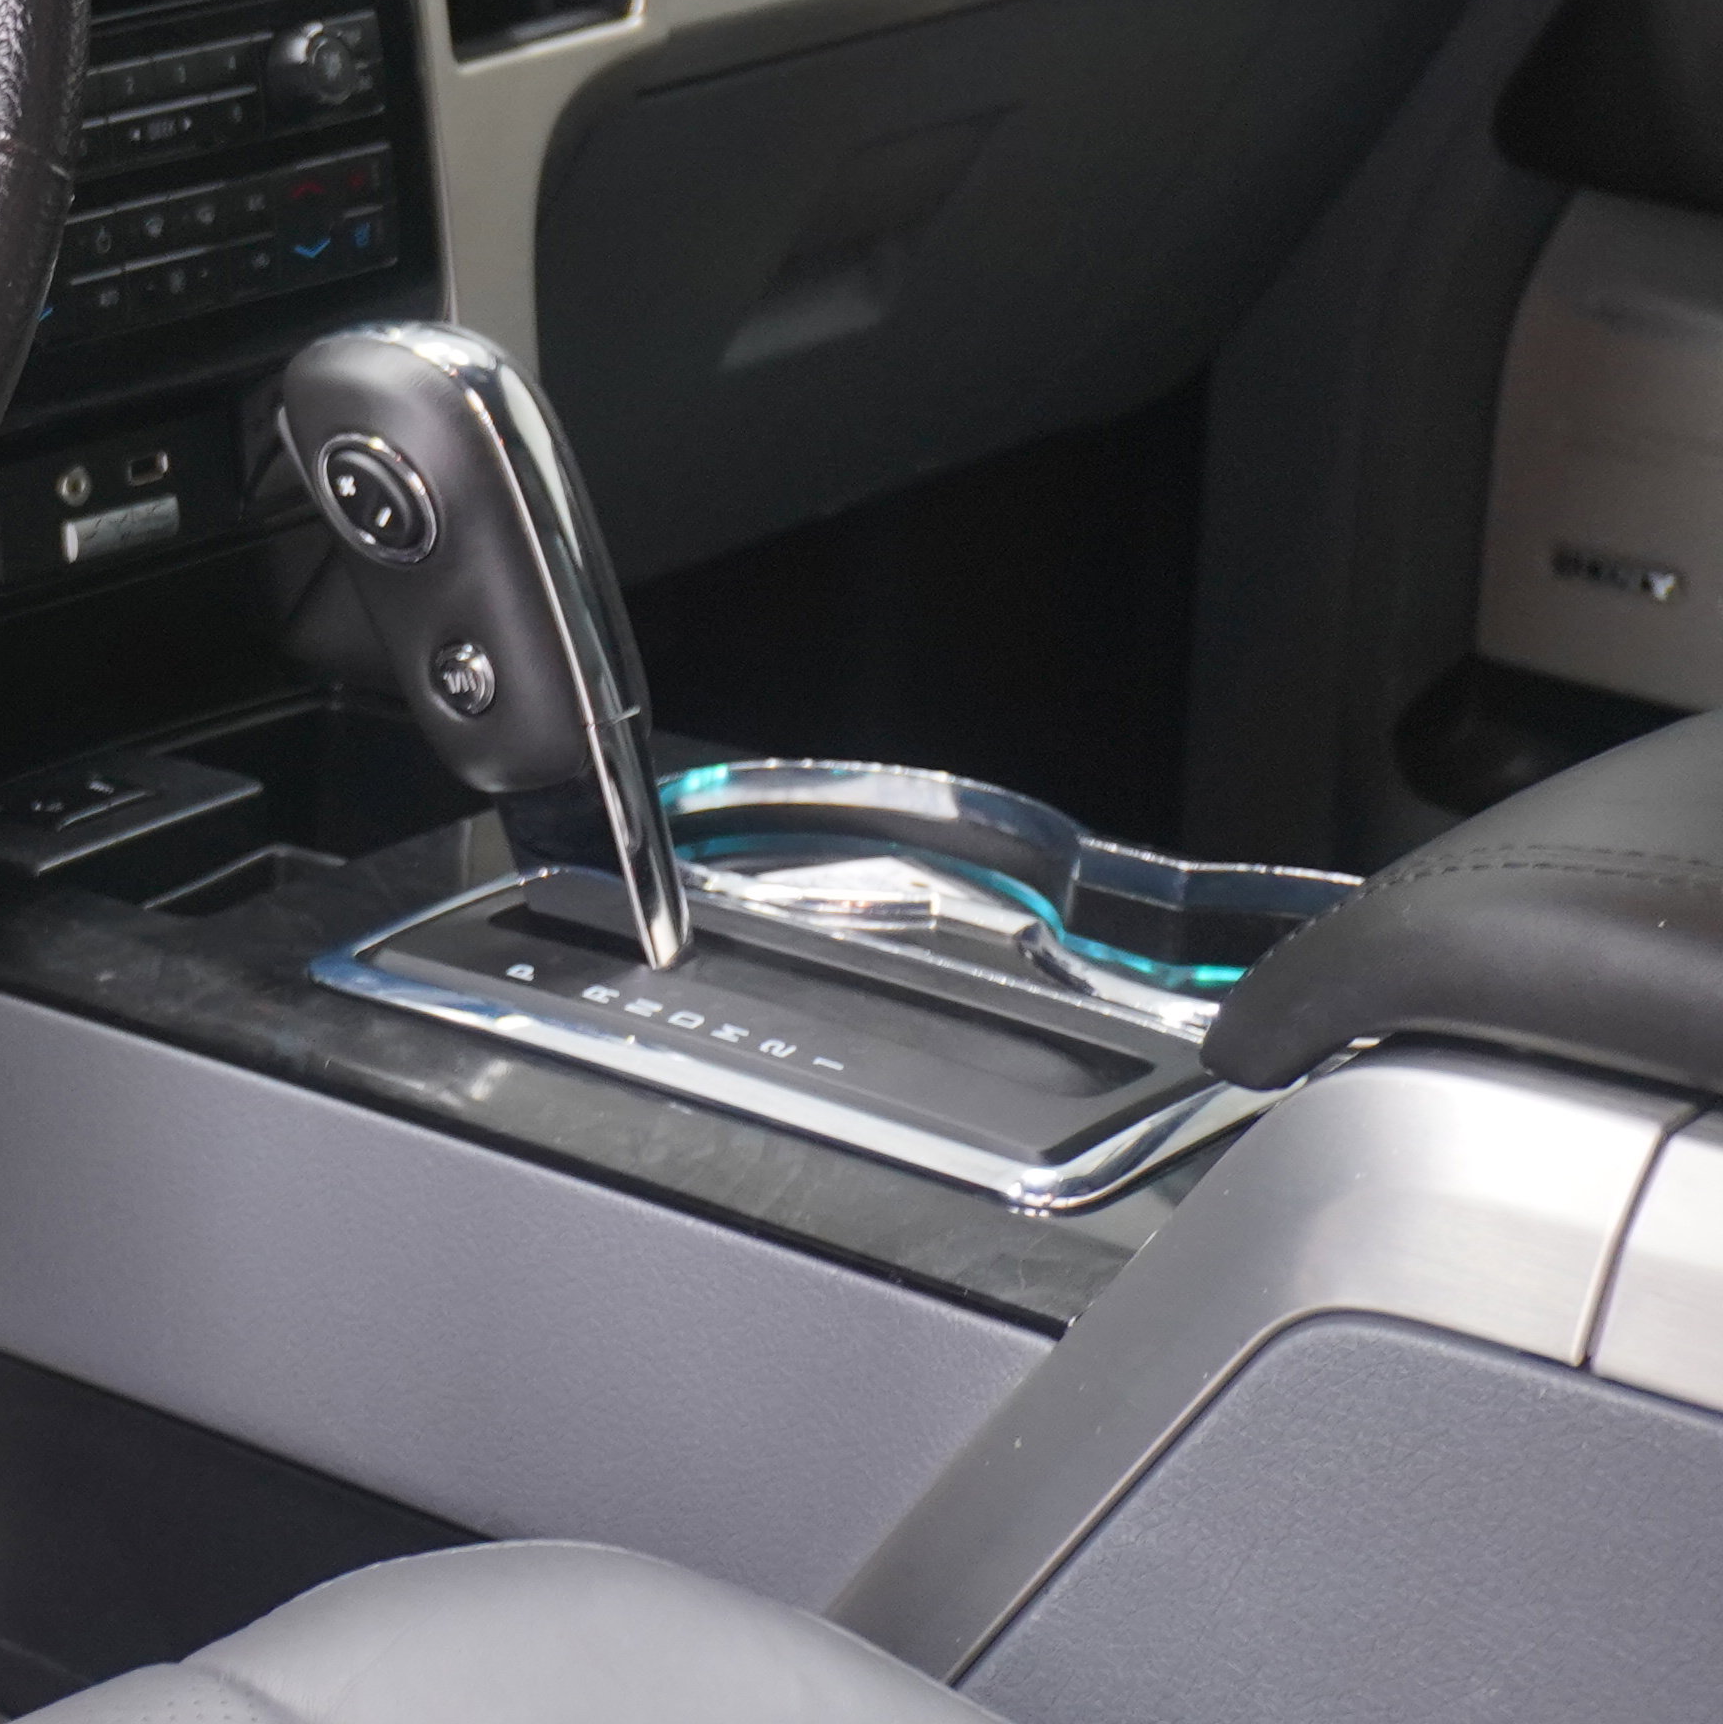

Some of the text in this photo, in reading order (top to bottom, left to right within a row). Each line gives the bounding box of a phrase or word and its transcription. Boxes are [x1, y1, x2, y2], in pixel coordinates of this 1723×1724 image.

[506, 963, 535, 982] P
[581, 984, 621, 1004] R
[624, 997, 663, 1018] N
[667, 1010, 705, 1030] D
[759, 1038, 797, 1058] 2
